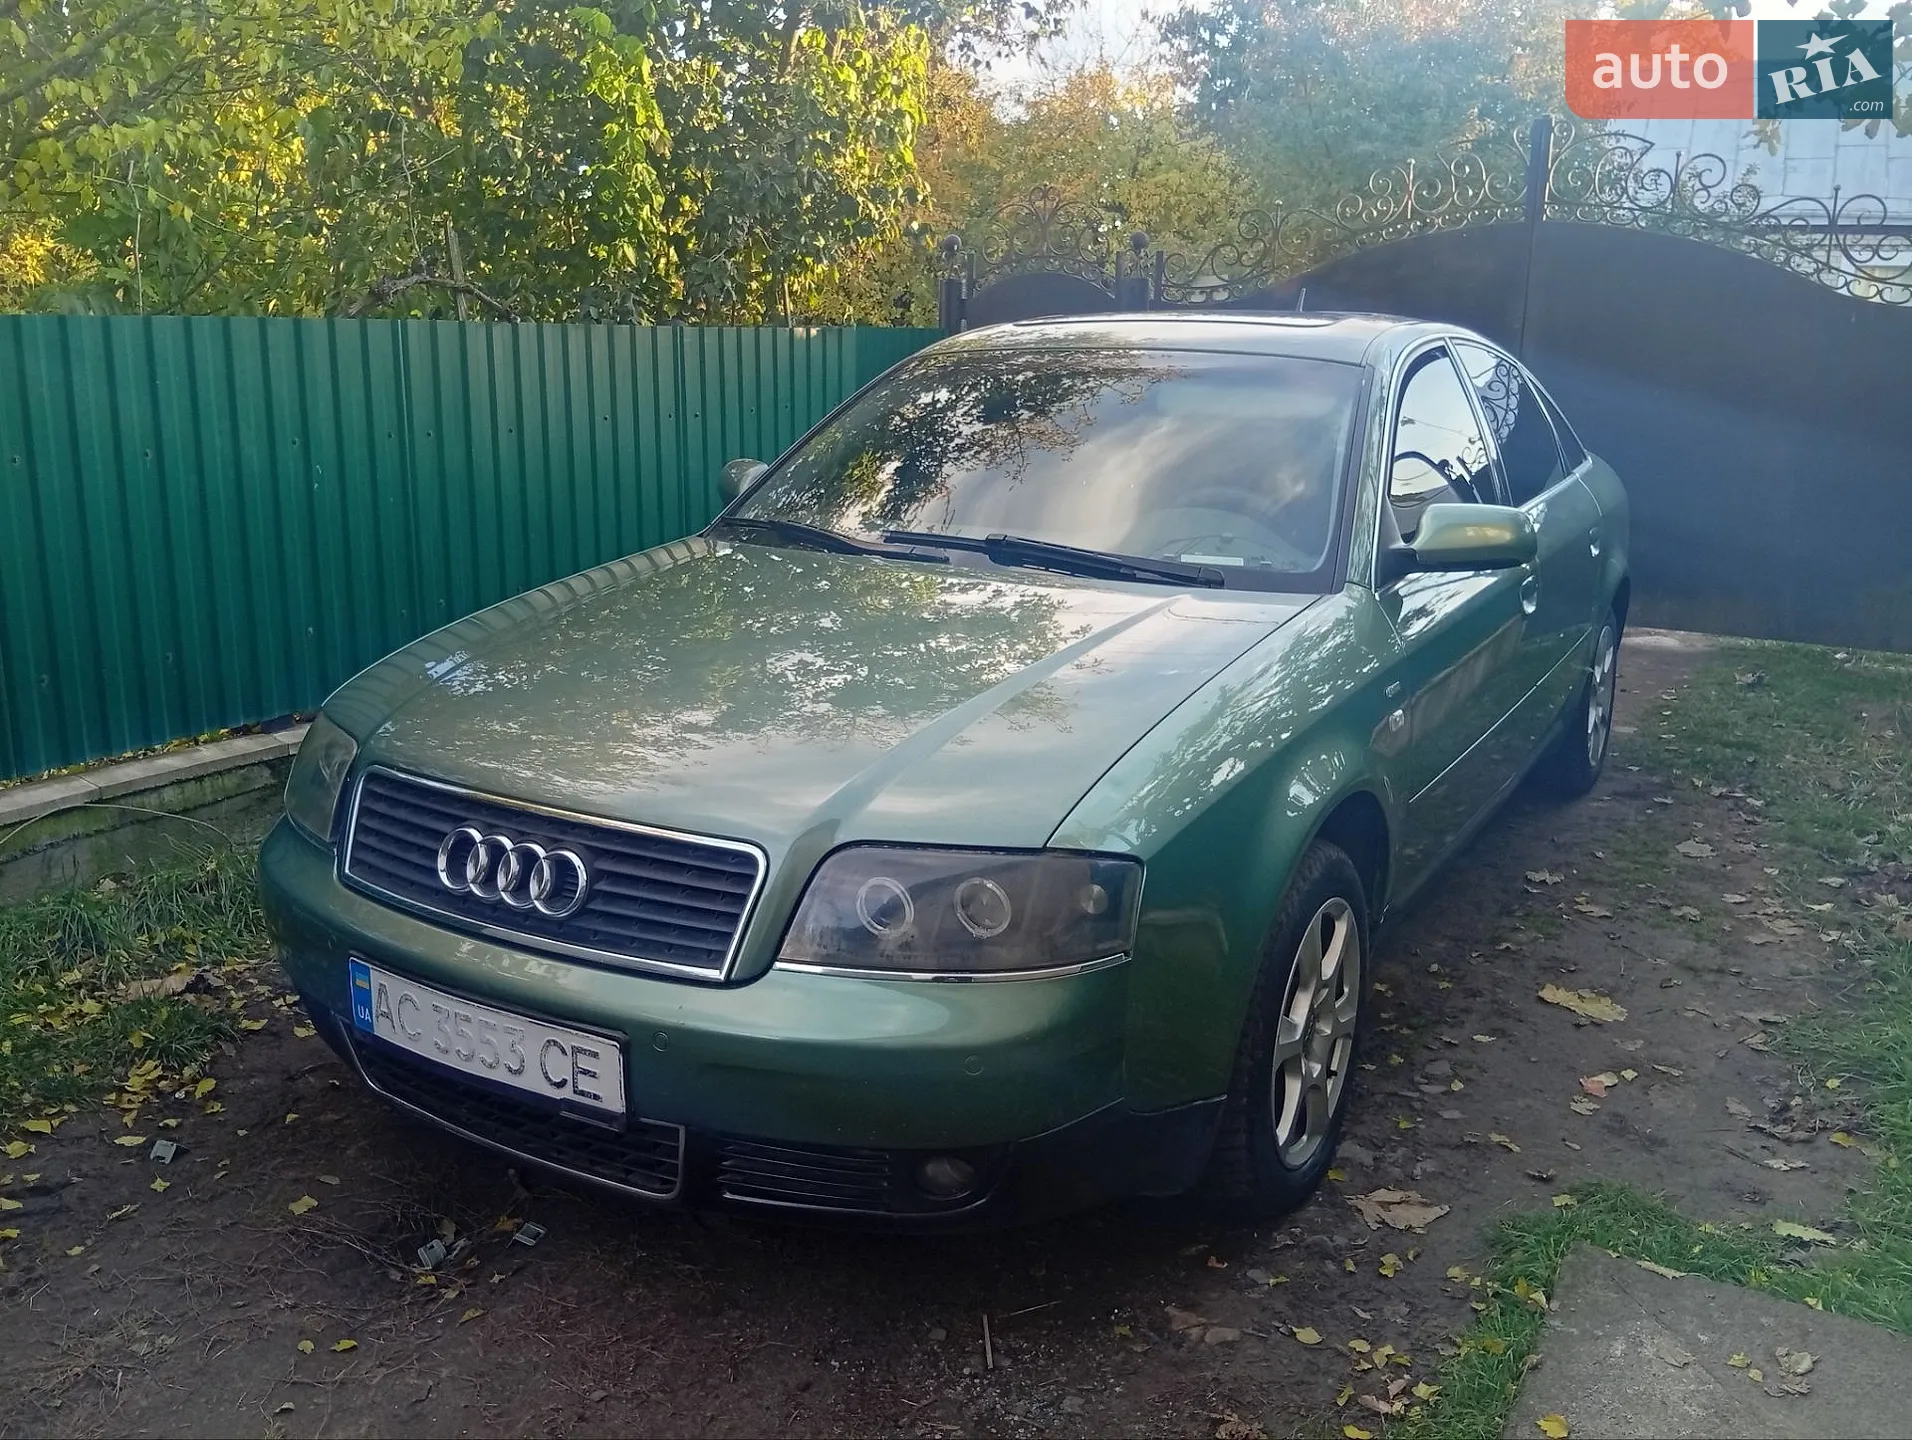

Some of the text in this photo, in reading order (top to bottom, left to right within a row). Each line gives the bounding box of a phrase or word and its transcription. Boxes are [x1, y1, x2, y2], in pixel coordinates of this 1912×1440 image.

[357, 1004, 371, 1023] UA
[376, 981, 603, 1103] AC 3553 CE
